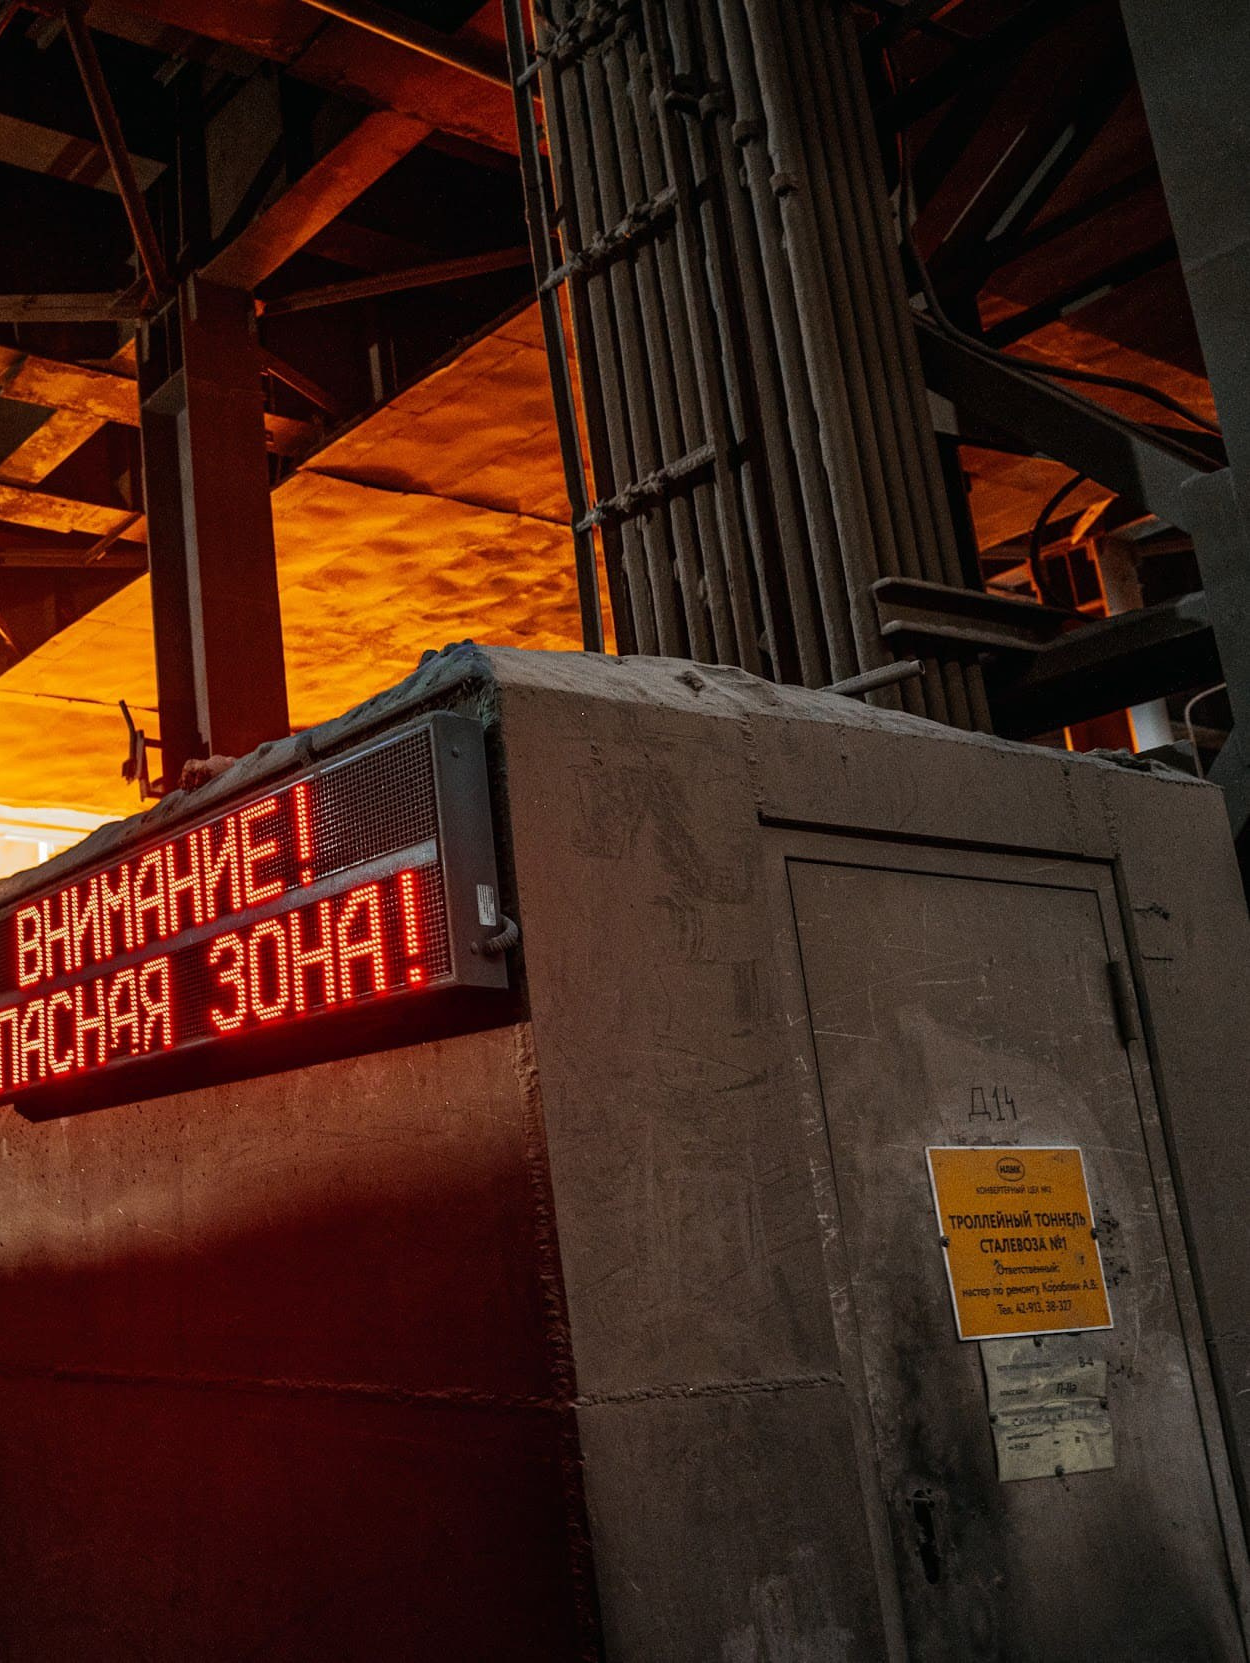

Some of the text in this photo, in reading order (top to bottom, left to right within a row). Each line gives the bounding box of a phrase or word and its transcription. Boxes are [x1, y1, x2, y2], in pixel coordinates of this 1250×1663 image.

[16, 783, 315, 989] ВНИМАНИЕ!
[208, 871, 424, 1034] ЗОНА!
[949, 1211, 1086, 1229] ТРОЛЛЕЙНЫЙ ТОННЕЛЬ
[980, 1238, 1047, 1253] СТАЛЕВОЗА
